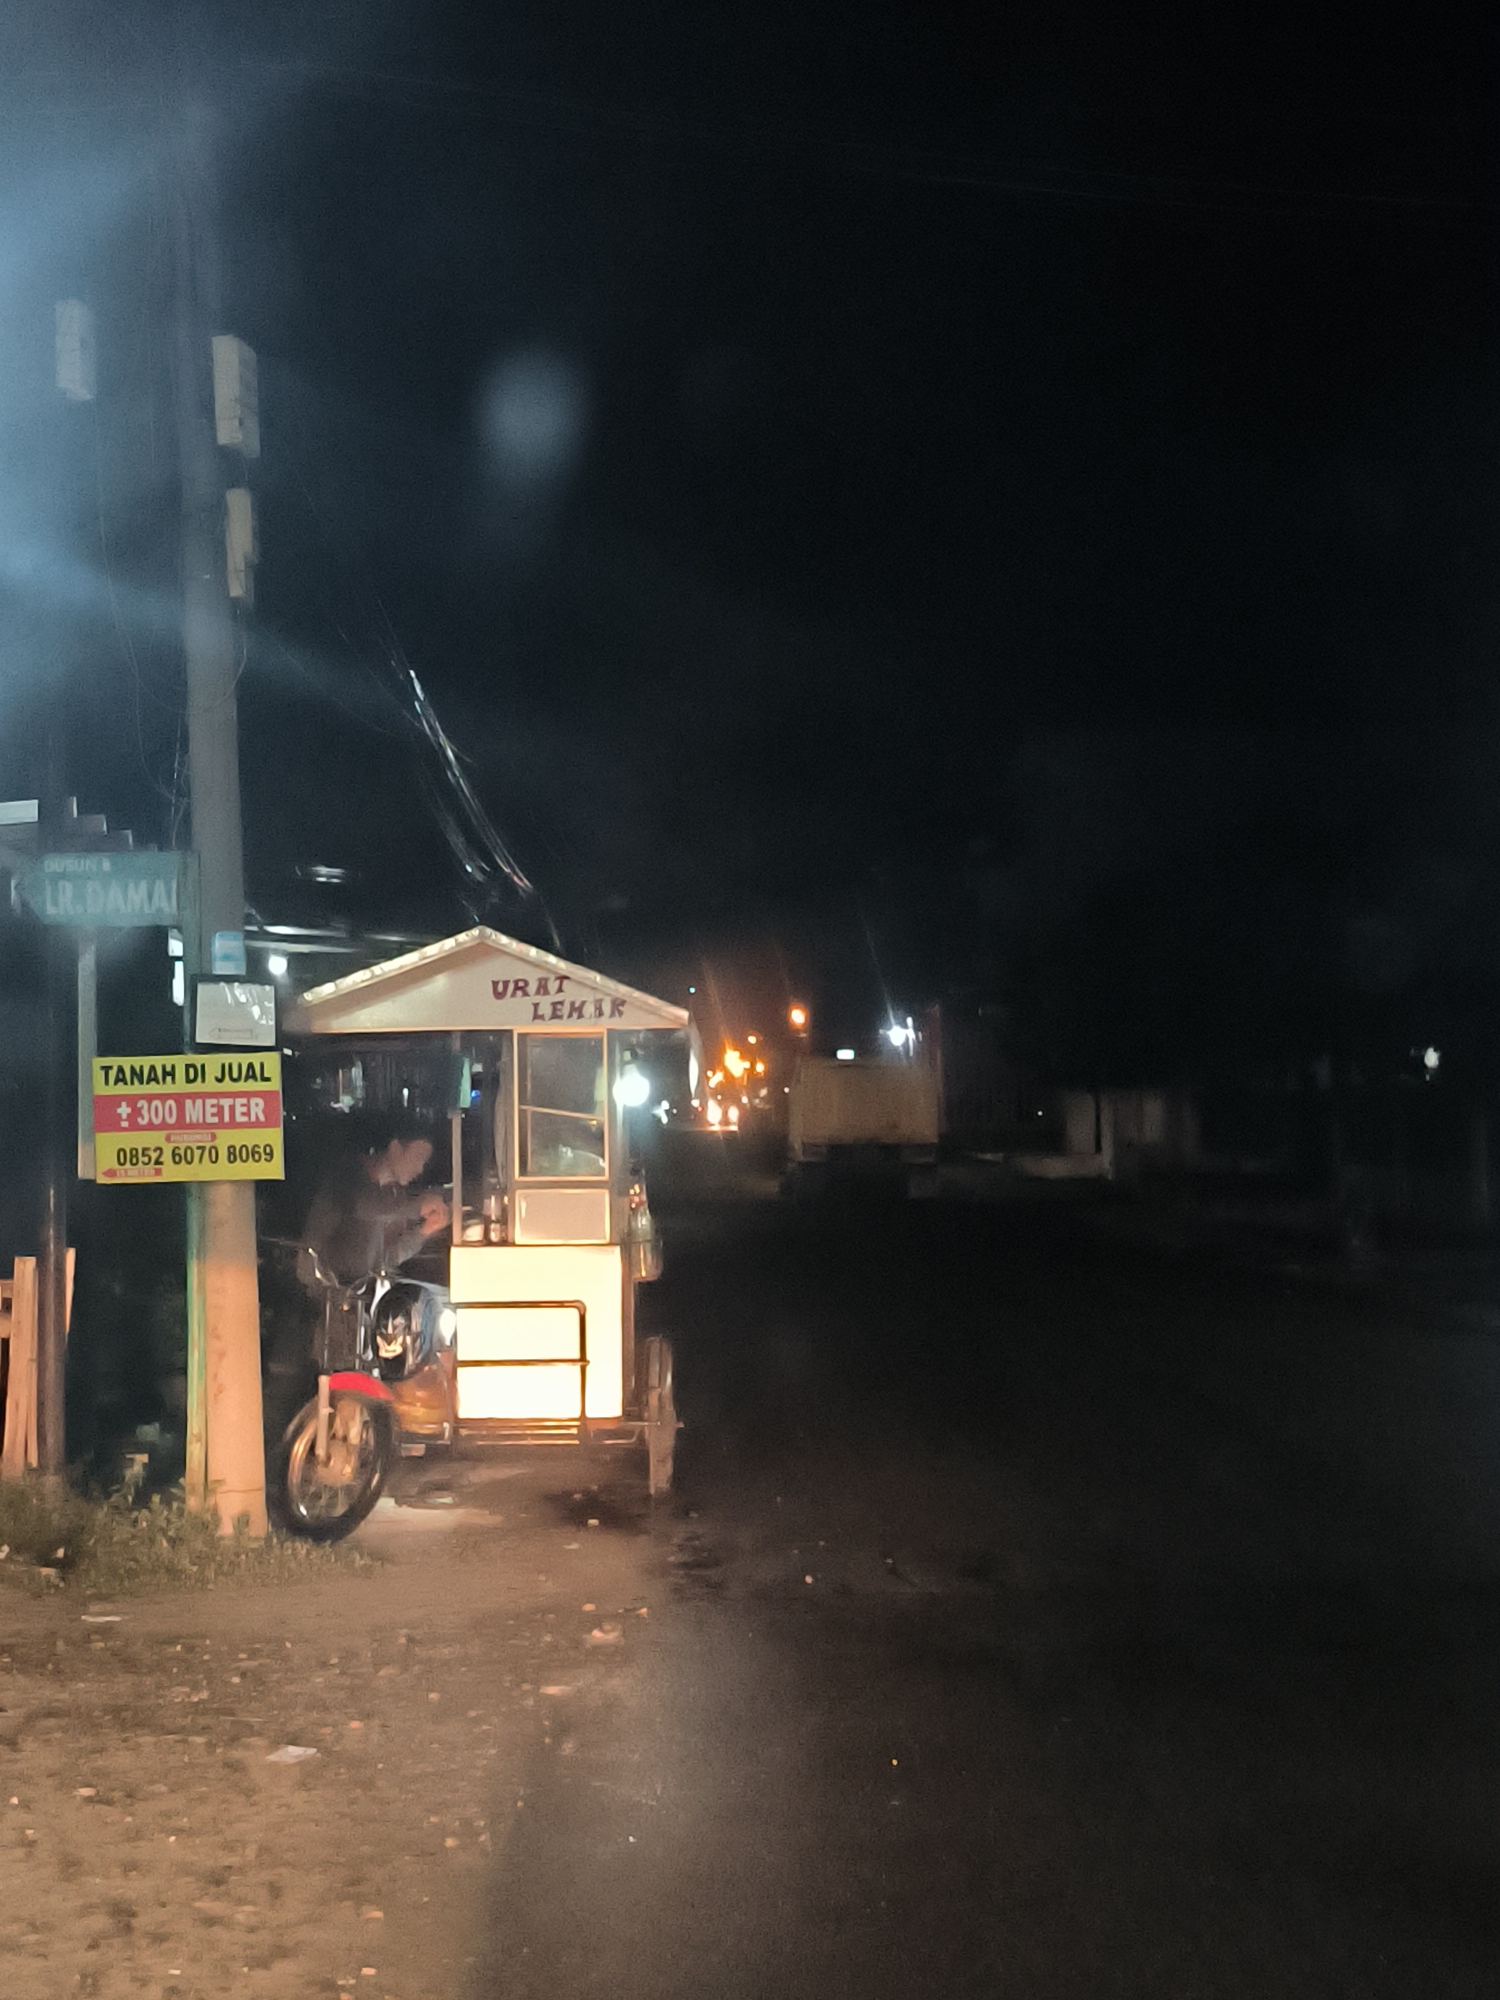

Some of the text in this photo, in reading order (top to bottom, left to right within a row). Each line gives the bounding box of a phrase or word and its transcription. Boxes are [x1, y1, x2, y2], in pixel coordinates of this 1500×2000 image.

[491, 975, 571, 1000] URAT
[100, 1061, 272, 1086] TANAH DI JUAL
[137, 1099, 177, 1125] 300
[185, 1097, 266, 1124] METER
[116, 1143, 274, 1166] 0852 6070 8069
